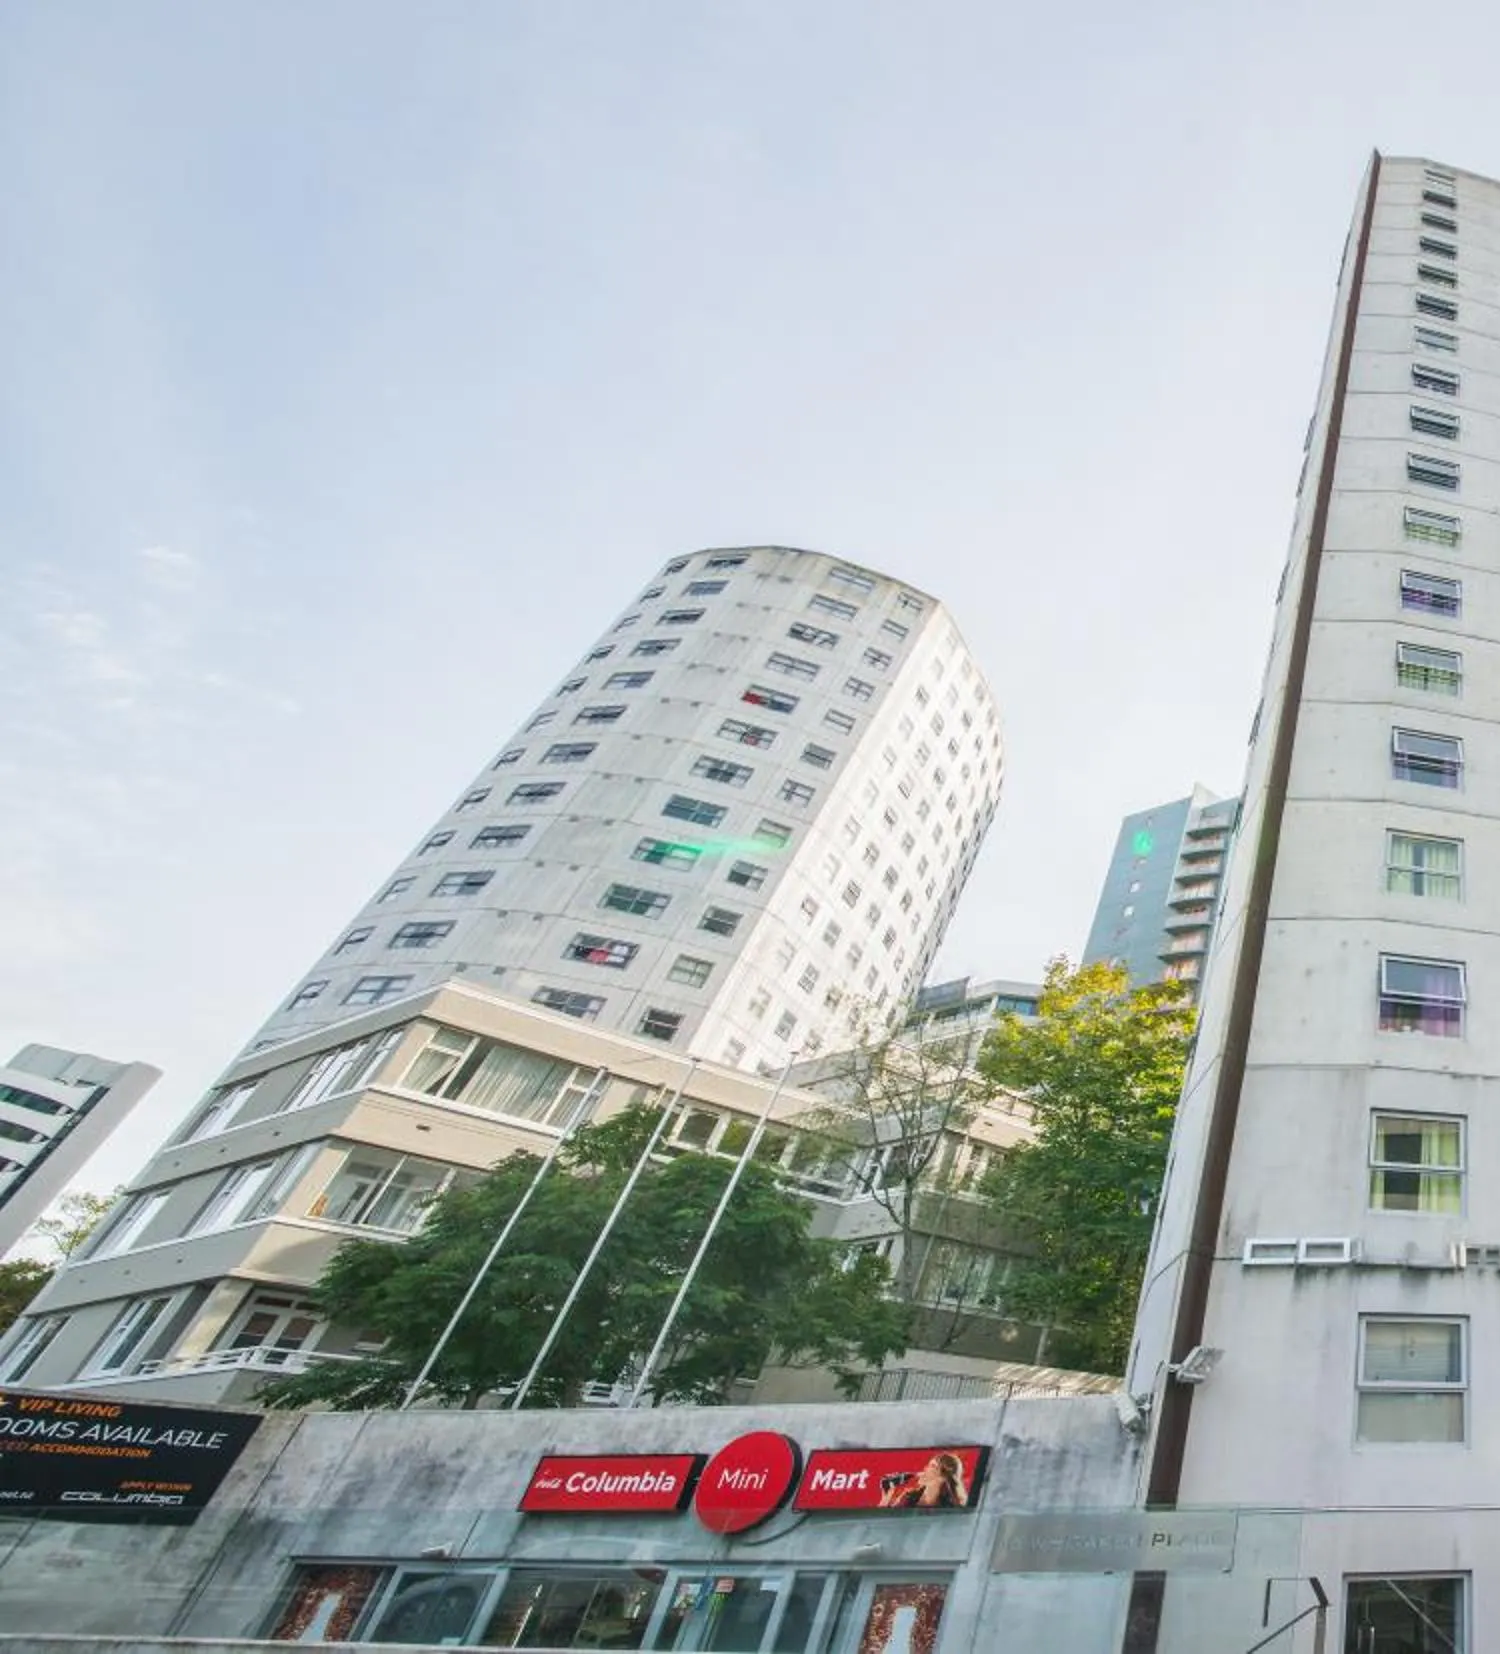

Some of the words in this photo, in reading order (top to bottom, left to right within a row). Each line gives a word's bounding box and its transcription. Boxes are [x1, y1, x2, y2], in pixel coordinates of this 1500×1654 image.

[18, 1398, 52, 1412] VIP
[54, 1403, 122, 1418] LIVING
[80, 1424, 228, 1449] AVAILABLE
[565, 1470, 676, 1493] Columbia
[716, 1467, 769, 1490] Mini
[810, 1468, 869, 1491] Mart
